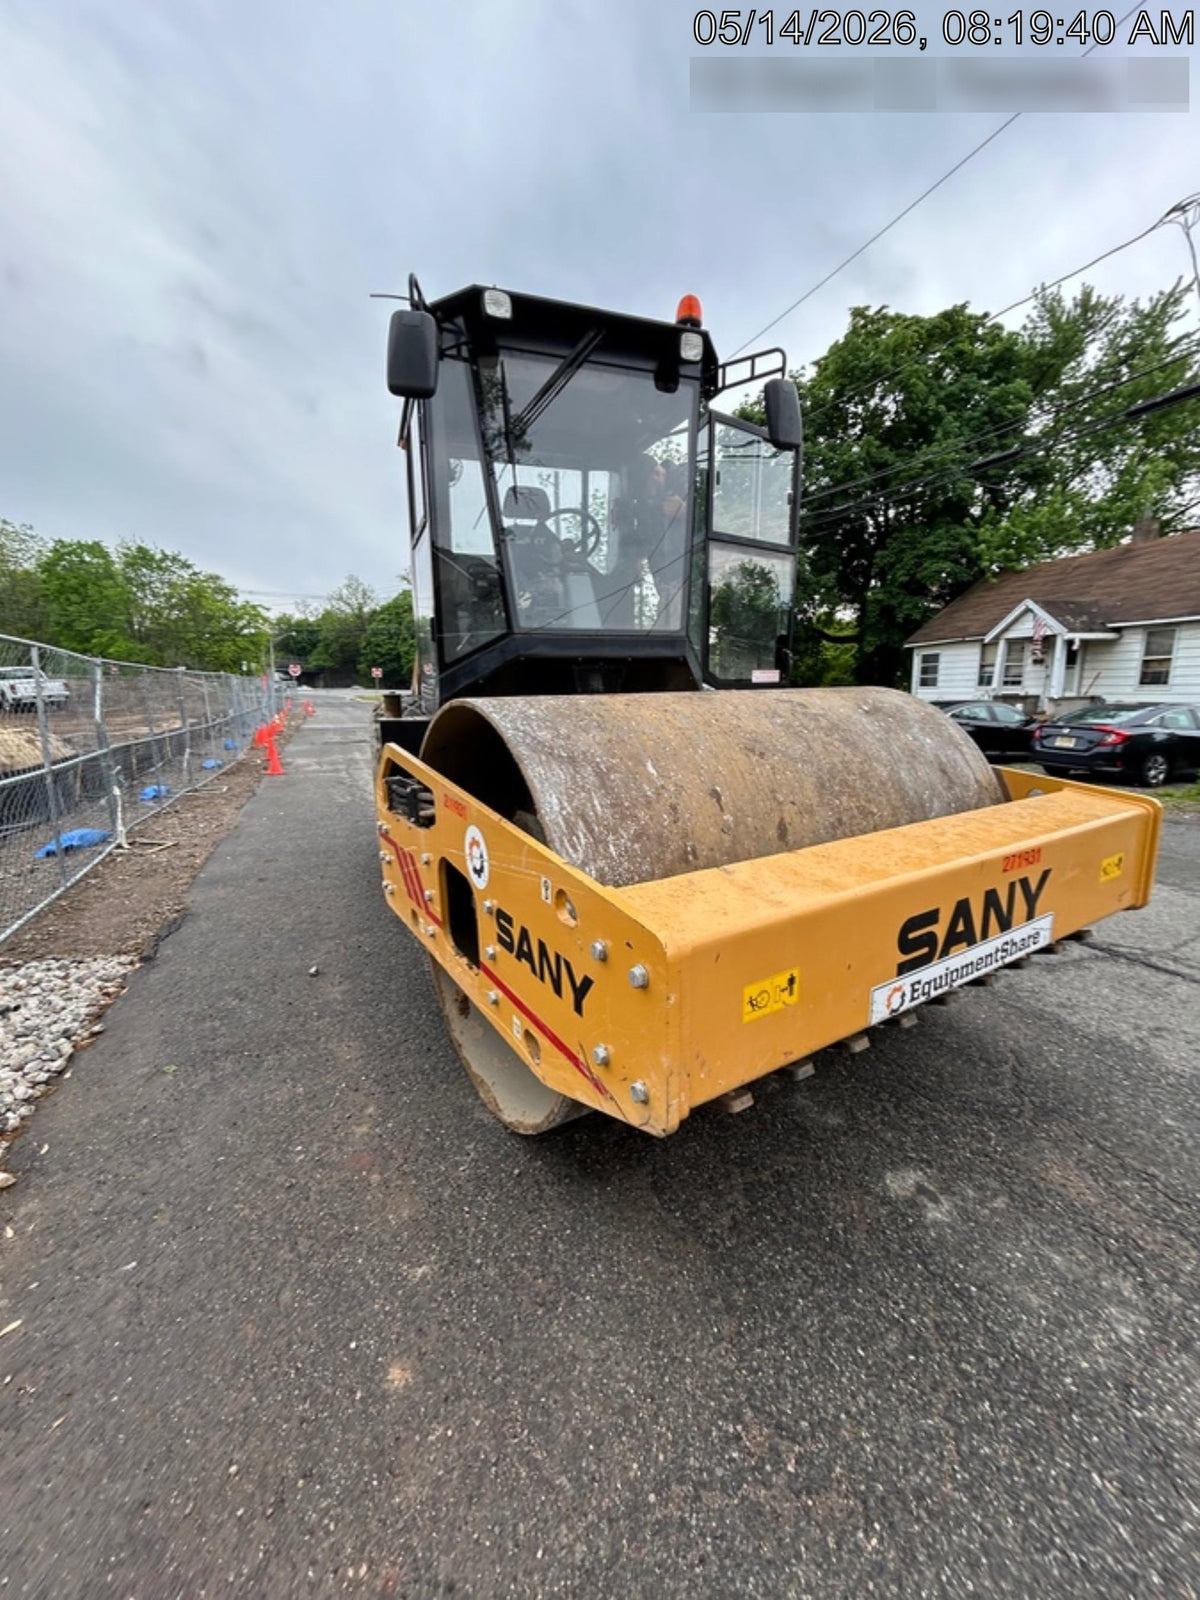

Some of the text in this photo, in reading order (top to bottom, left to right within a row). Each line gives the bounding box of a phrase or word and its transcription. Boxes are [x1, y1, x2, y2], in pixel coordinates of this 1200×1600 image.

[495, 907, 595, 1018] SANY
[897, 868, 1052, 978] SANY
[909, 930, 1040, 1002] EquipmentShare
